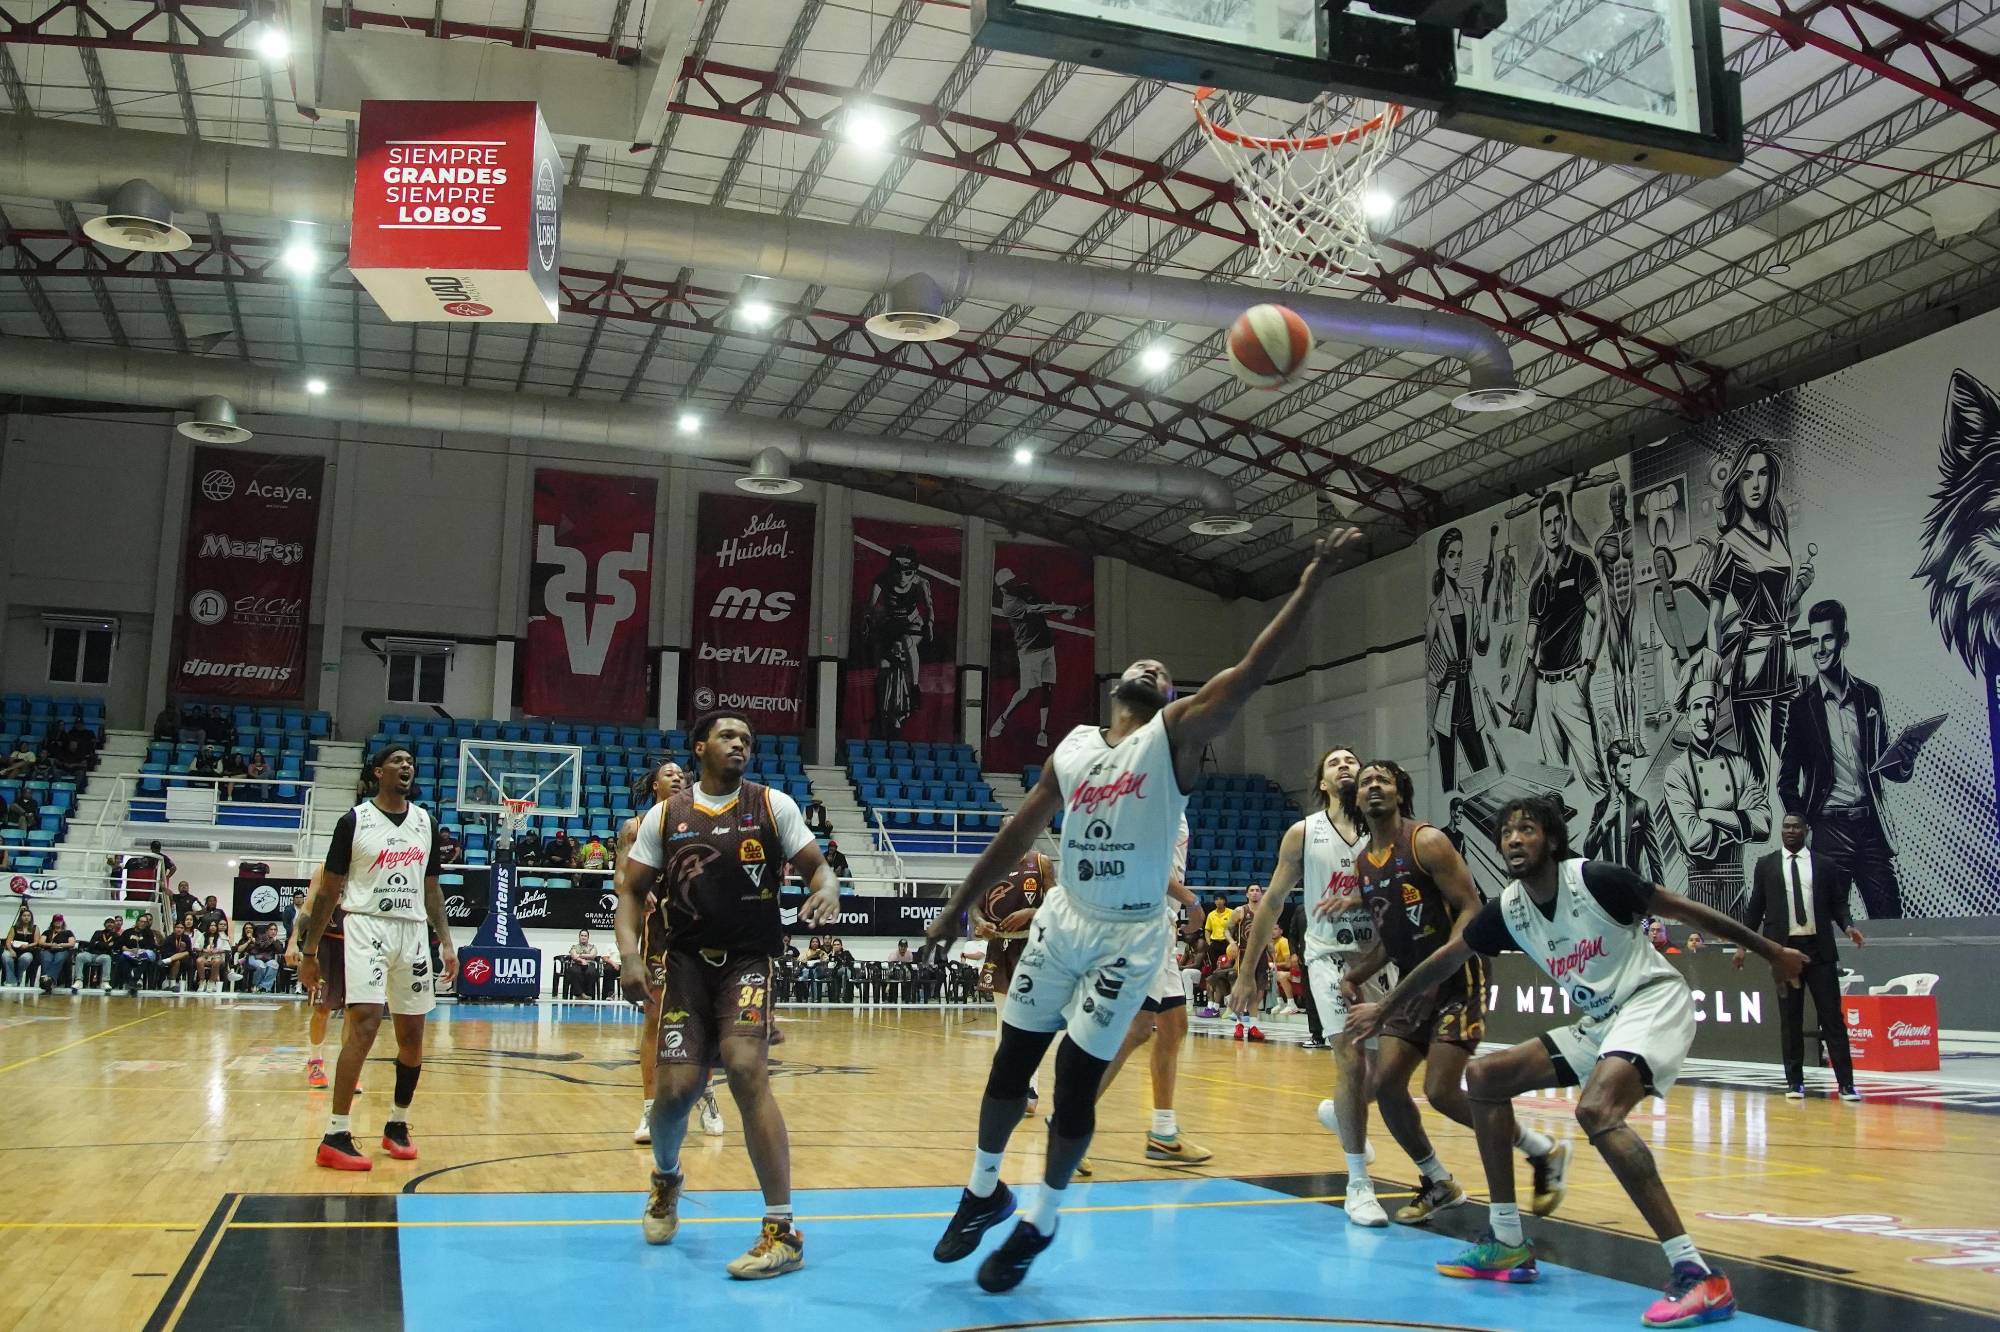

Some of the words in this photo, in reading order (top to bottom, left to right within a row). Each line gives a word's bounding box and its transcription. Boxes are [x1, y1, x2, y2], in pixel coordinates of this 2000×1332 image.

[388, 147, 498, 166] SIEMPRE
[383, 167, 508, 185] GRANDES
[385, 187, 496, 204] SIEMPRE
[399, 206, 487, 223] LOBOS
[425, 276, 472, 302] UAD
[741, 512, 787, 538] Salsa
[199, 533, 303, 566] MazFest
[716, 531, 788, 567] Huichol
[234, 596, 264, 613] El
[265, 598, 303, 615] Cid
[182, 657, 292, 681] dportenis
[1094, 860, 1125, 877] UAD
[30, 879, 58, 891] CID
[280, 886, 309, 896] COLEIO
[494, 867, 509, 946] dportenis
[518, 889, 547, 906] Salsa
[900, 906, 945, 919] POWE
[494, 958, 536, 978] UAD
[1690, 989, 1761, 1024] CLN
[1887, 1020, 1932, 1040] Caliente
[660, 1049, 688, 1058] MEGA
